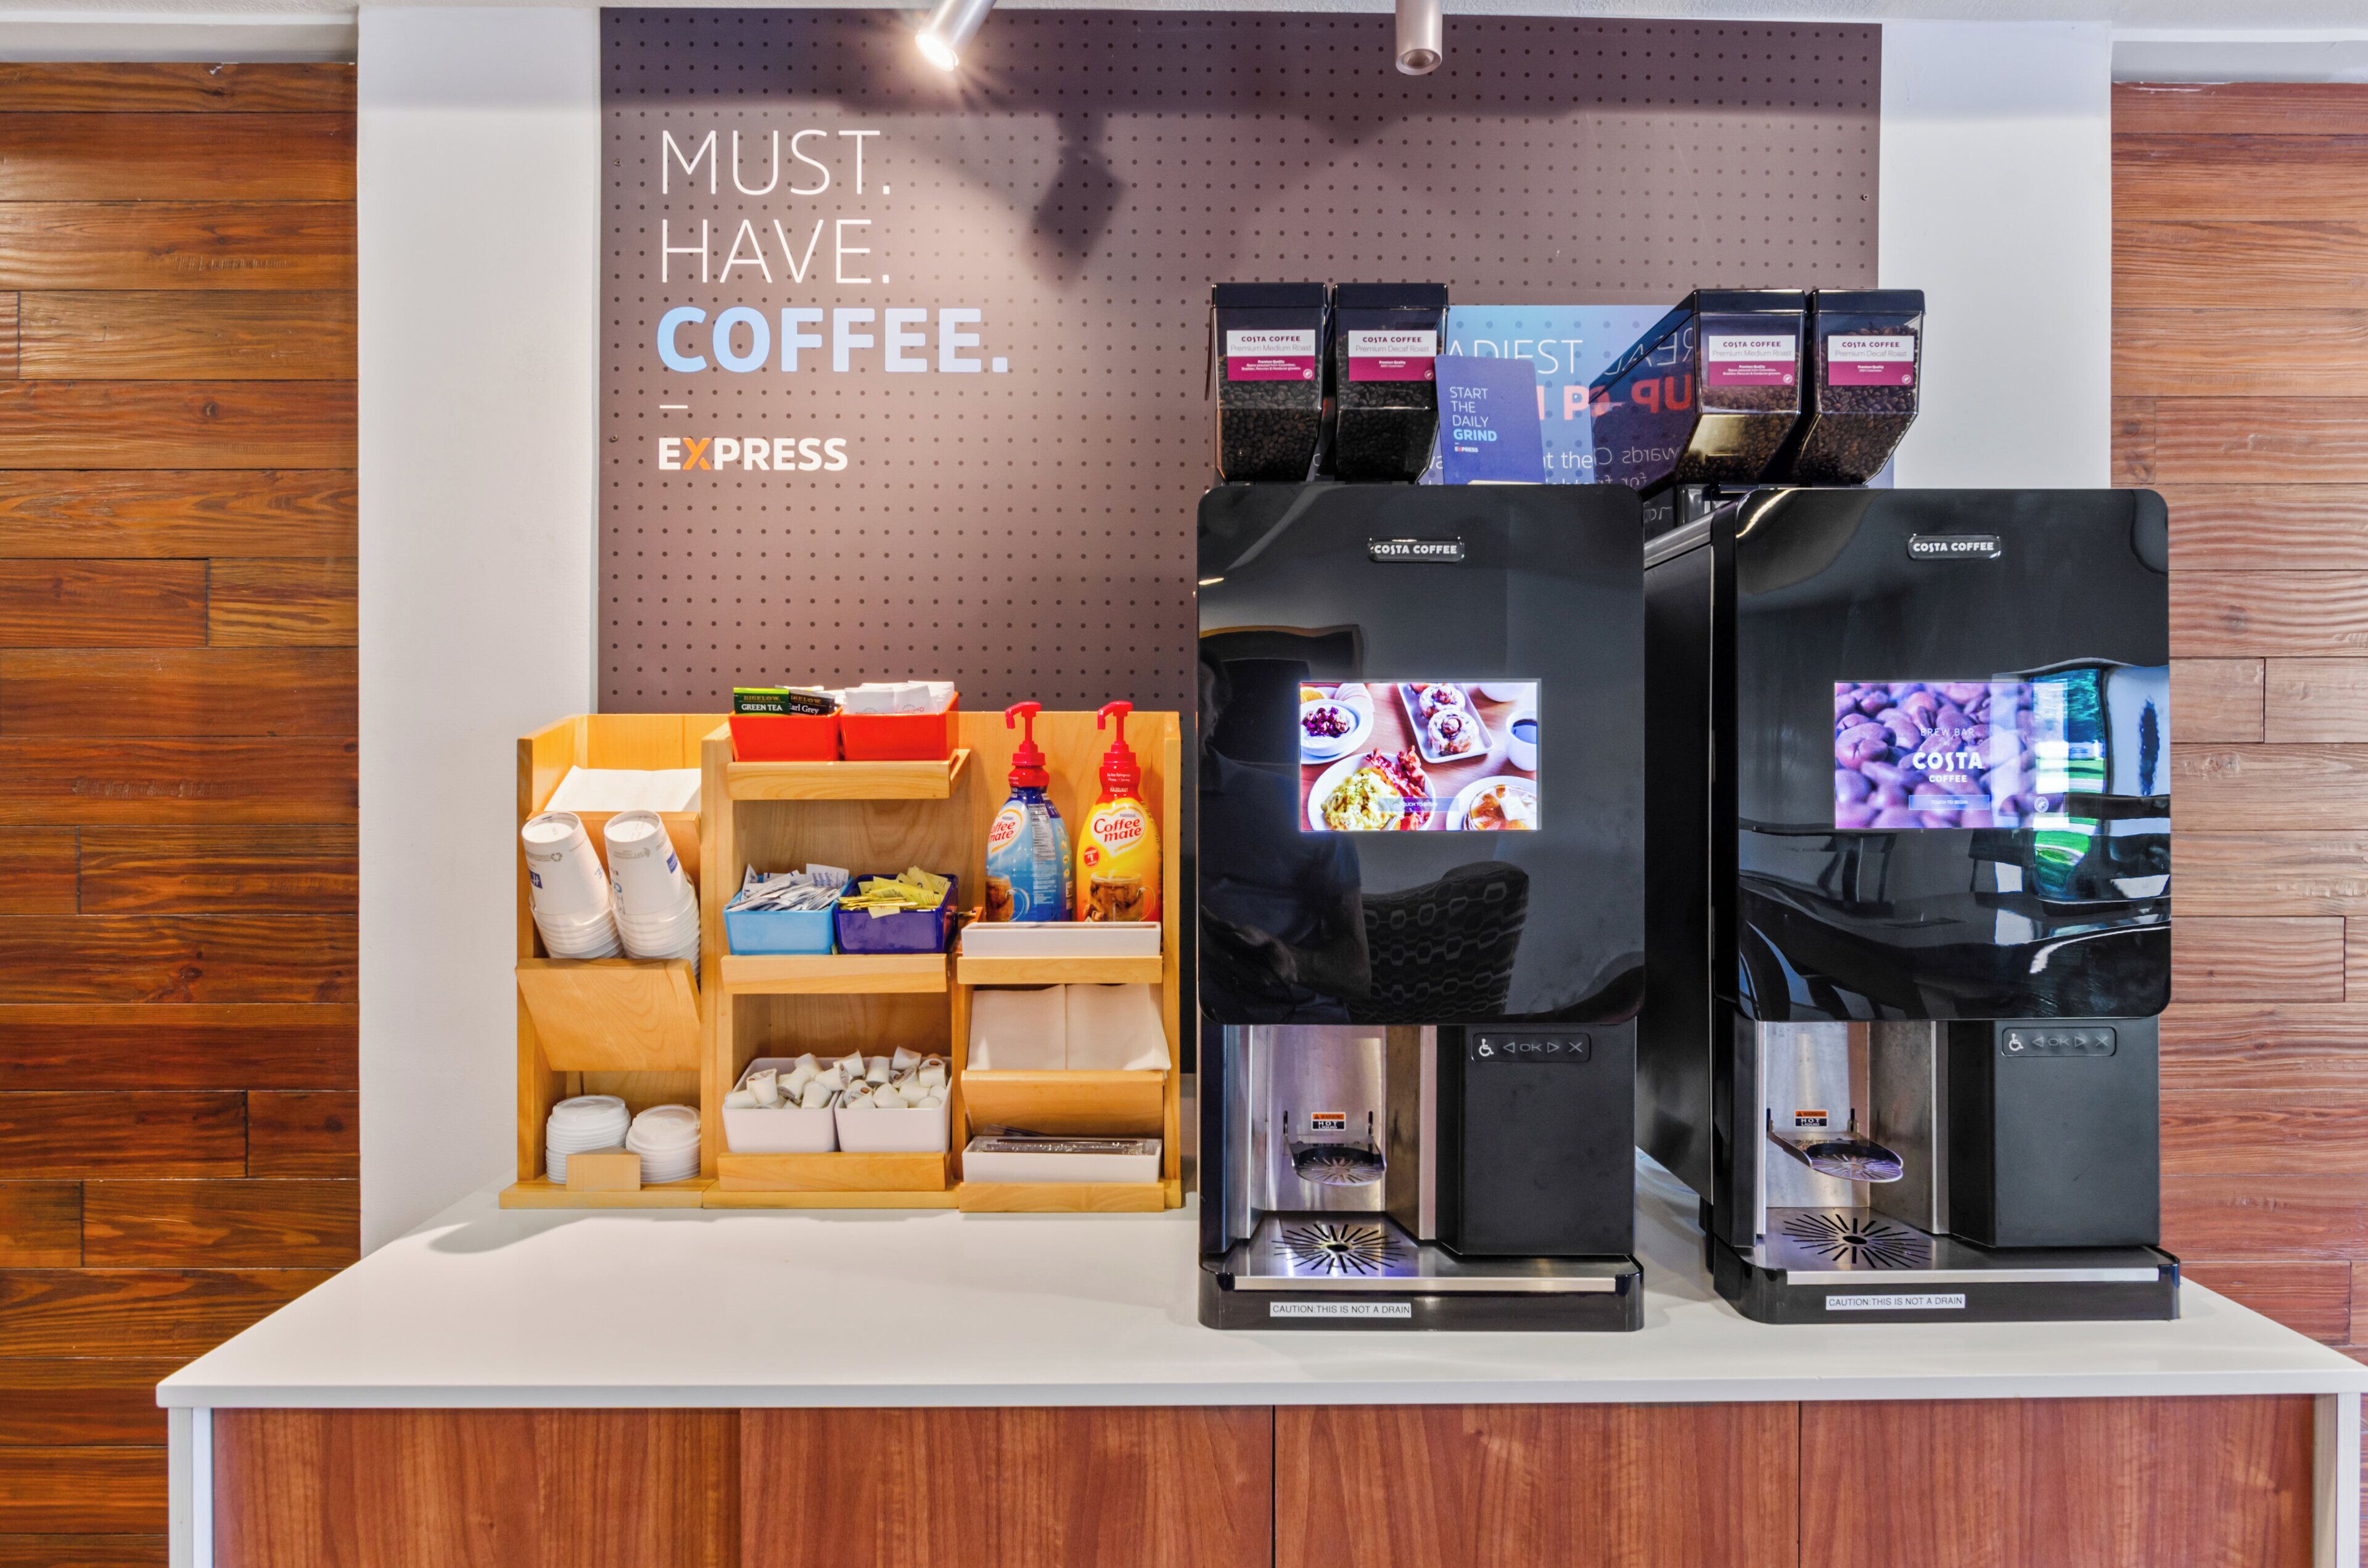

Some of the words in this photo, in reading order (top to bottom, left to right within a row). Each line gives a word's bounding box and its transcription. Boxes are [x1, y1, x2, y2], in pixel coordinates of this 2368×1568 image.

[662, 129, 890, 195] MUST.
[662, 218, 890, 284] HAVE.
[656, 306, 1008, 373] COFFEE.
[1449, 387, 1489, 400] START
[1450, 401, 1476, 413] THE
[1452, 414, 1489, 427] DAILY
[1453, 429, 1497, 441] GRIND
[659, 437, 848, 471] EXPRESS
[1561, 451, 1593, 469] the
[1374, 544, 1410, 555] COSTA
[1413, 544, 1458, 554] COFFEE
[1913, 543, 1947, 552] COSTA
[1951, 542, 1994, 551] COFFEE
[790, 695, 822, 704] IGELOW
[802, 705, 820, 715] Grey
[1920, 728, 1950, 736] BREW
[1954, 728, 1974, 736] BAR
[1912, 751, 1983, 772] COSTA
[1929, 774, 1968, 783] COFFEE
[990, 821, 1016, 834] offee
[1094, 818, 1140, 834] Coffee
[1104, 827, 1141, 842] mate
[1520, 1043, 1542, 1052] OK
[2048, 1038, 2070, 1046] OK
[1894, 1298, 1902, 1306] IS
[1906, 1297, 1923, 1305] NOT
[1935, 1297, 1962, 1305] DRAIN
[1340, 1305, 1349, 1313] IS
[1351, 1305, 1370, 1313] NOT
[1382, 1305, 1410, 1313] DRAIN
